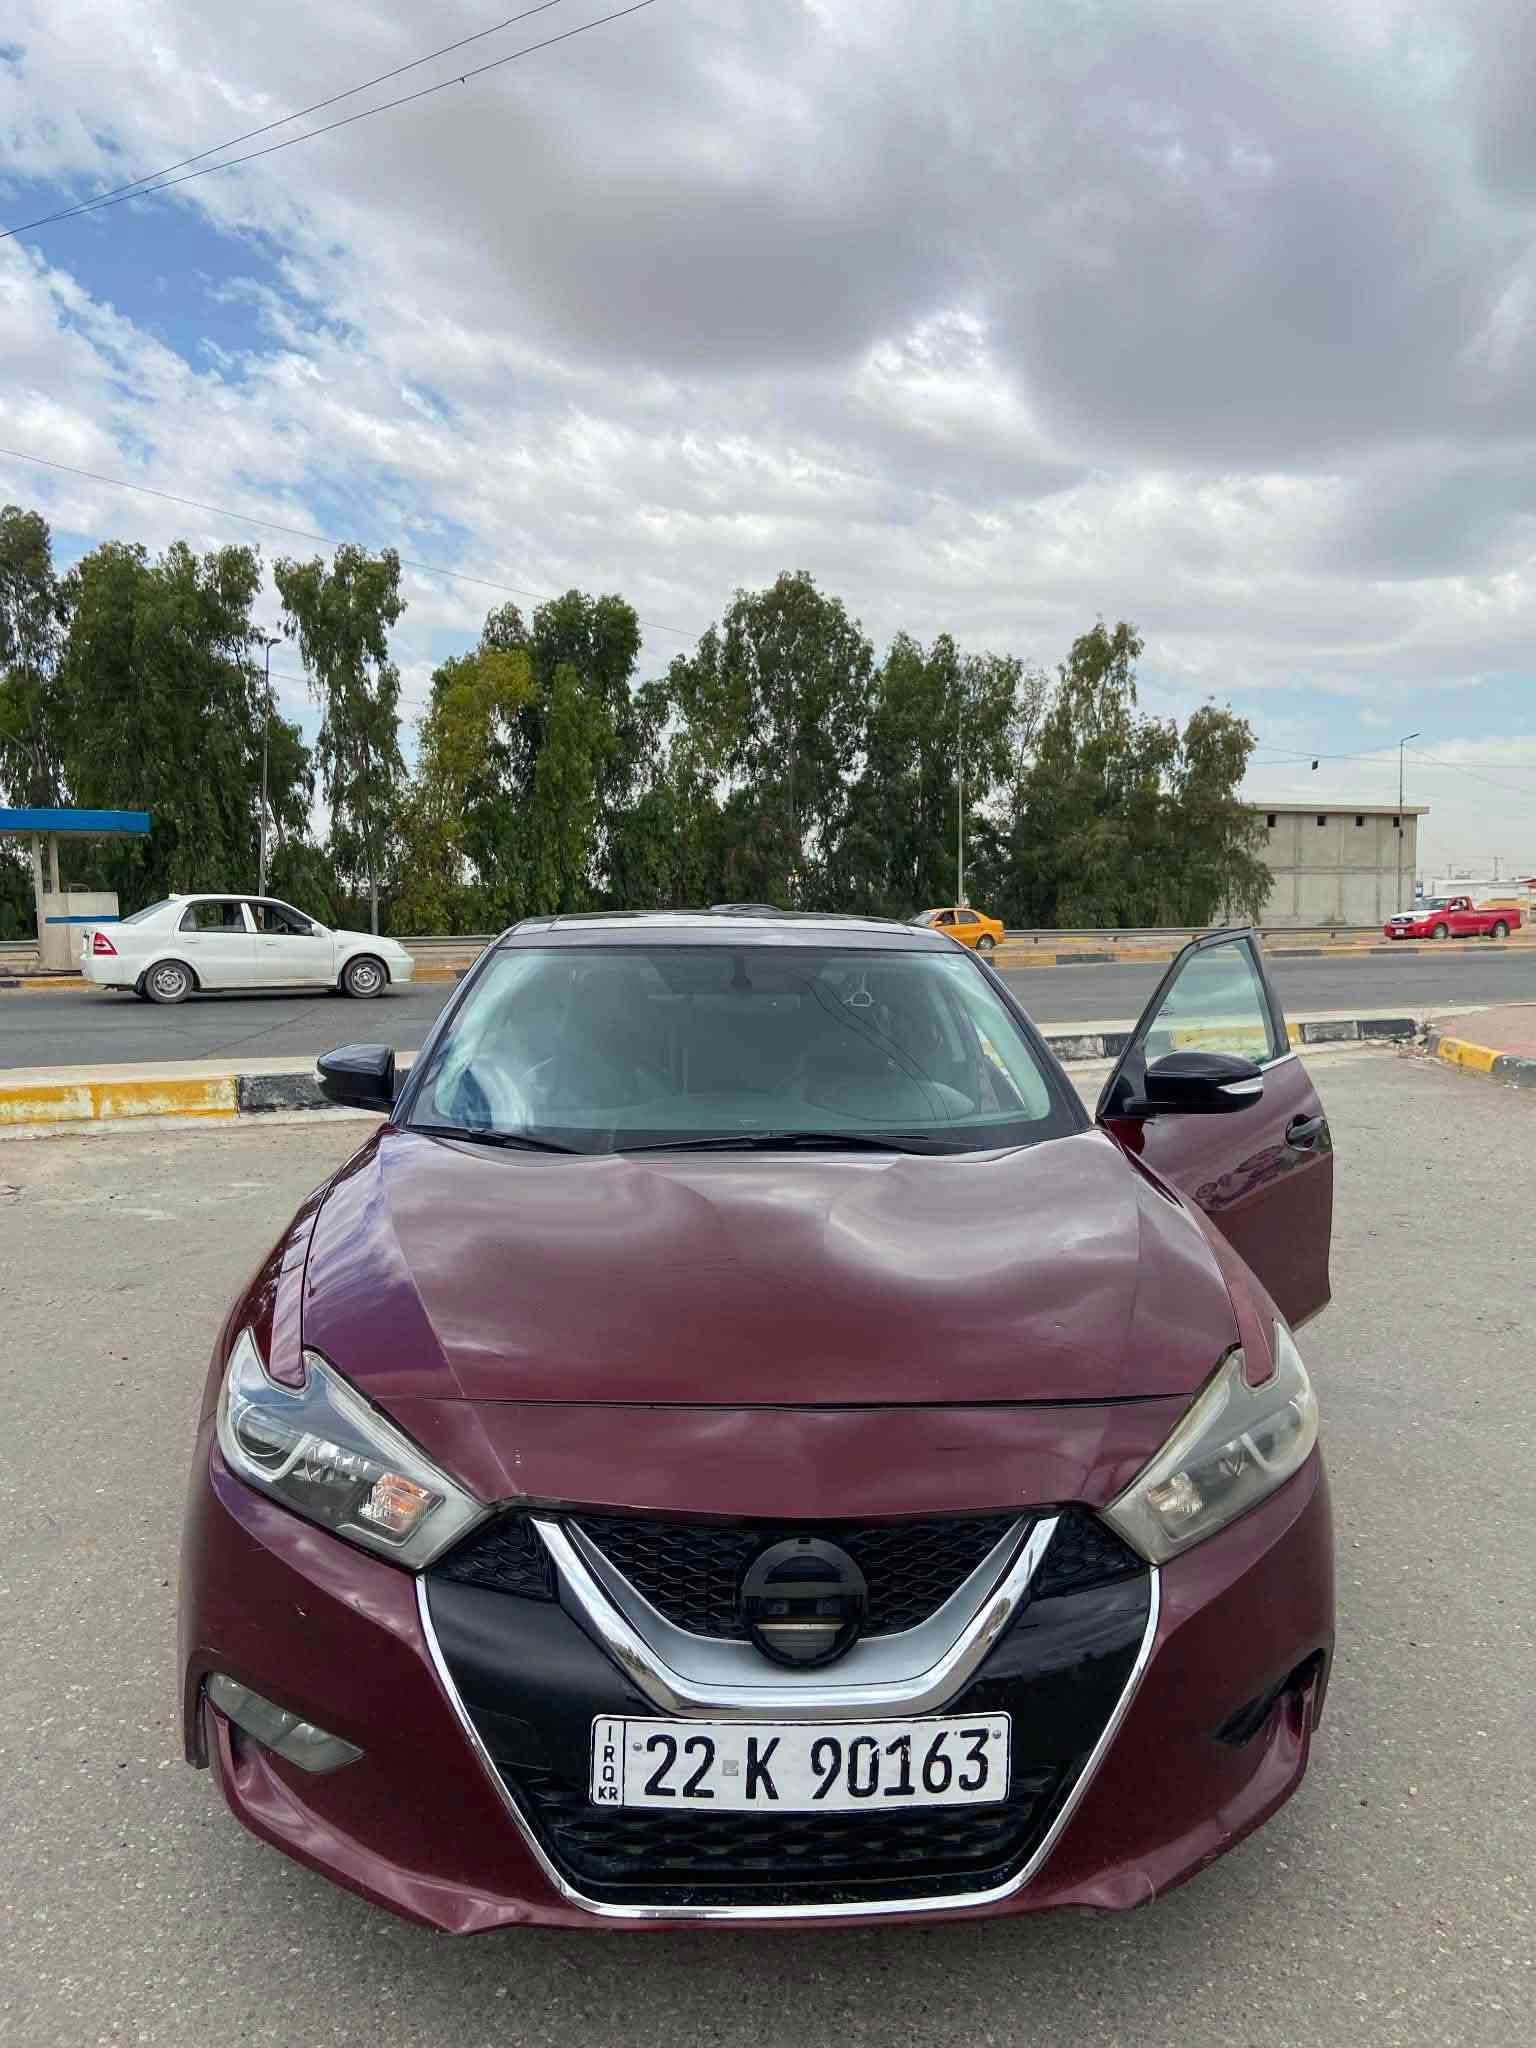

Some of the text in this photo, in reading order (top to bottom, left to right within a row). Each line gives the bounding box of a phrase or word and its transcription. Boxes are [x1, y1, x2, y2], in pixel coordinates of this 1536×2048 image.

[602, 1725, 615, 1782] IRQ
[644, 1728, 989, 1800] 22 K 90163
[598, 1786, 618, 1801] KR
